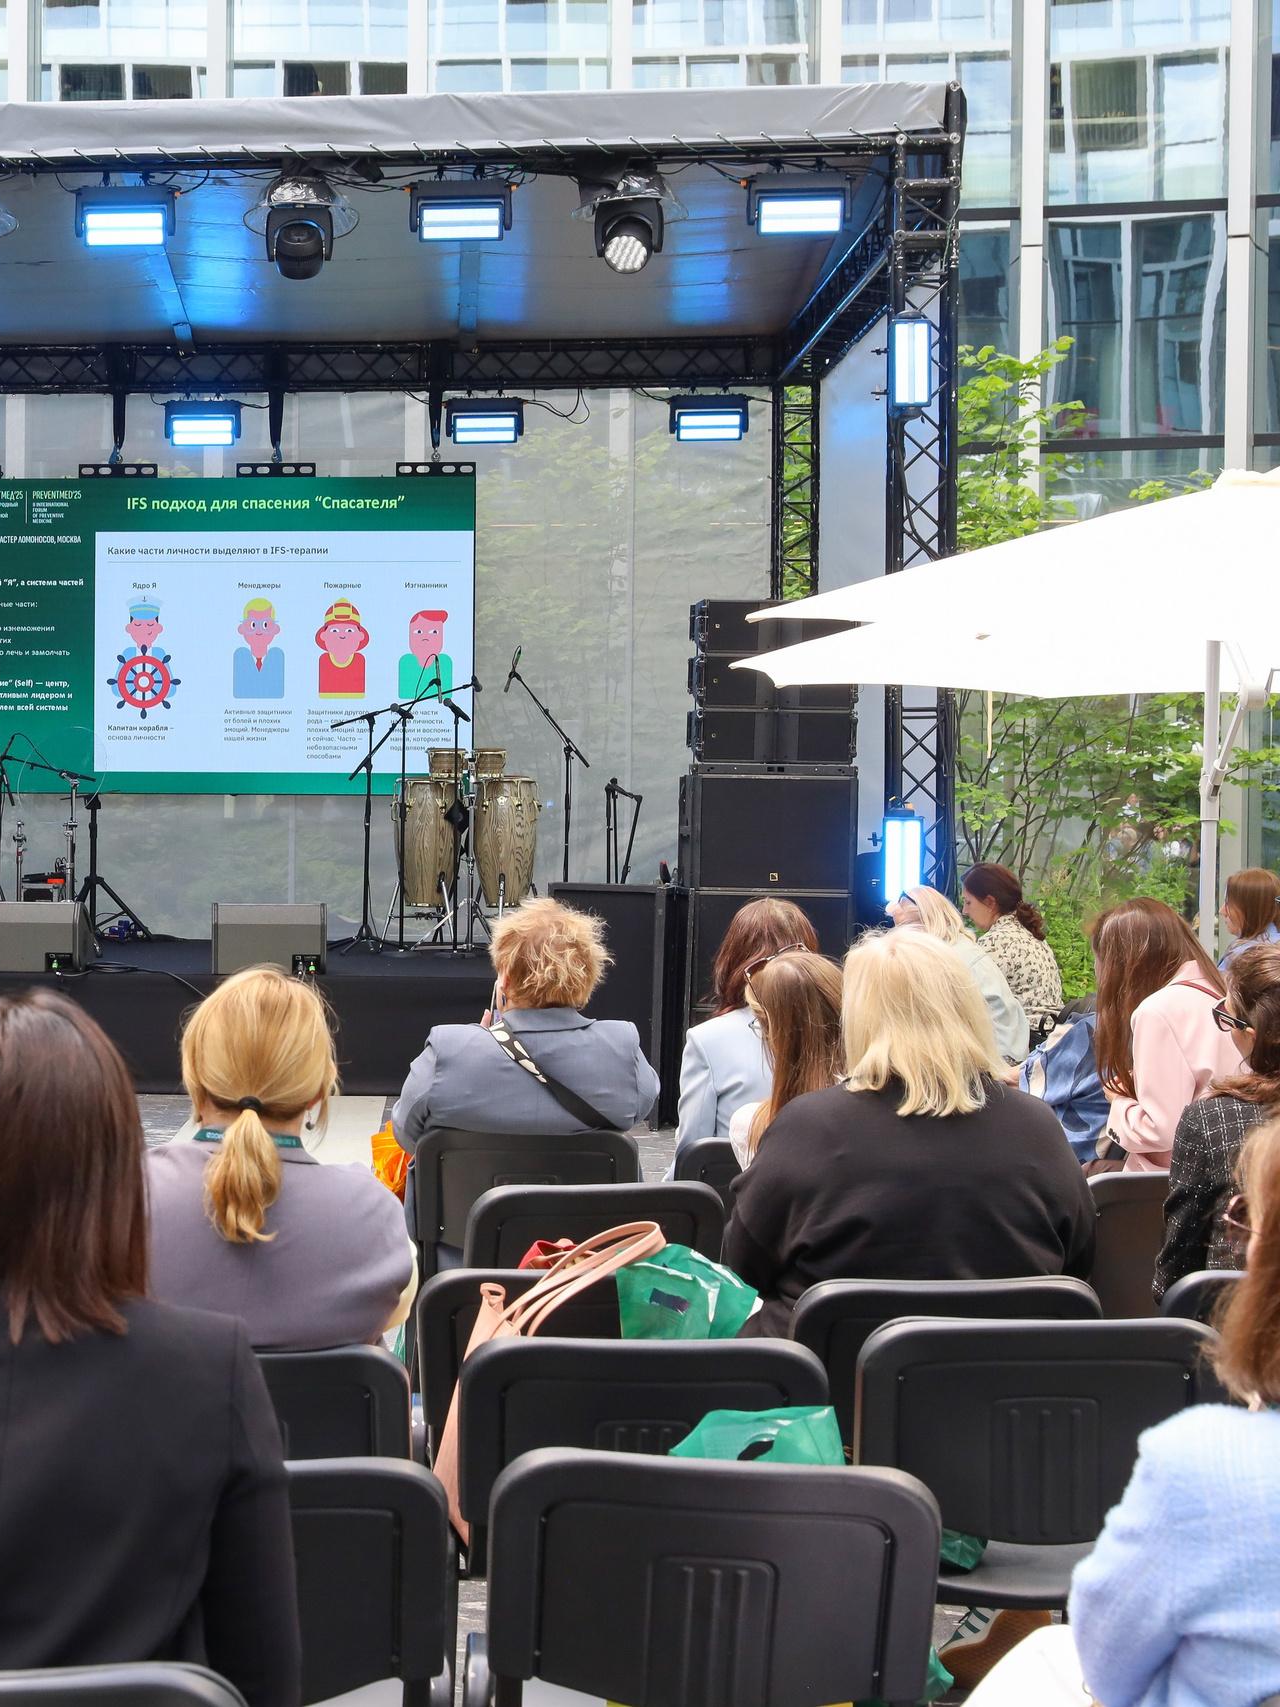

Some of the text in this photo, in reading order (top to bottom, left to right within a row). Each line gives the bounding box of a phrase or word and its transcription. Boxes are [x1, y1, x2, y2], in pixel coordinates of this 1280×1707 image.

[127, 497, 147, 510] IFS
[151, 499, 207, 512] подход
[210, 499, 238, 512] для
[242, 499, 310, 510] спасения
[18, 536, 56, 545] ЛОМОНОСОВ,
[57, 536, 82, 544] МОСКВА
[107, 547, 136, 555] Какие
[213, 548, 260, 556] выделяют
[270, 547, 329, 556] IFS-терапии
[238, 582, 281, 590] Менеджеры
[14, 679, 33, 687] (Self)
[17, 703, 34, 711] всей
[251, 726, 289, 734] Менеджеры
